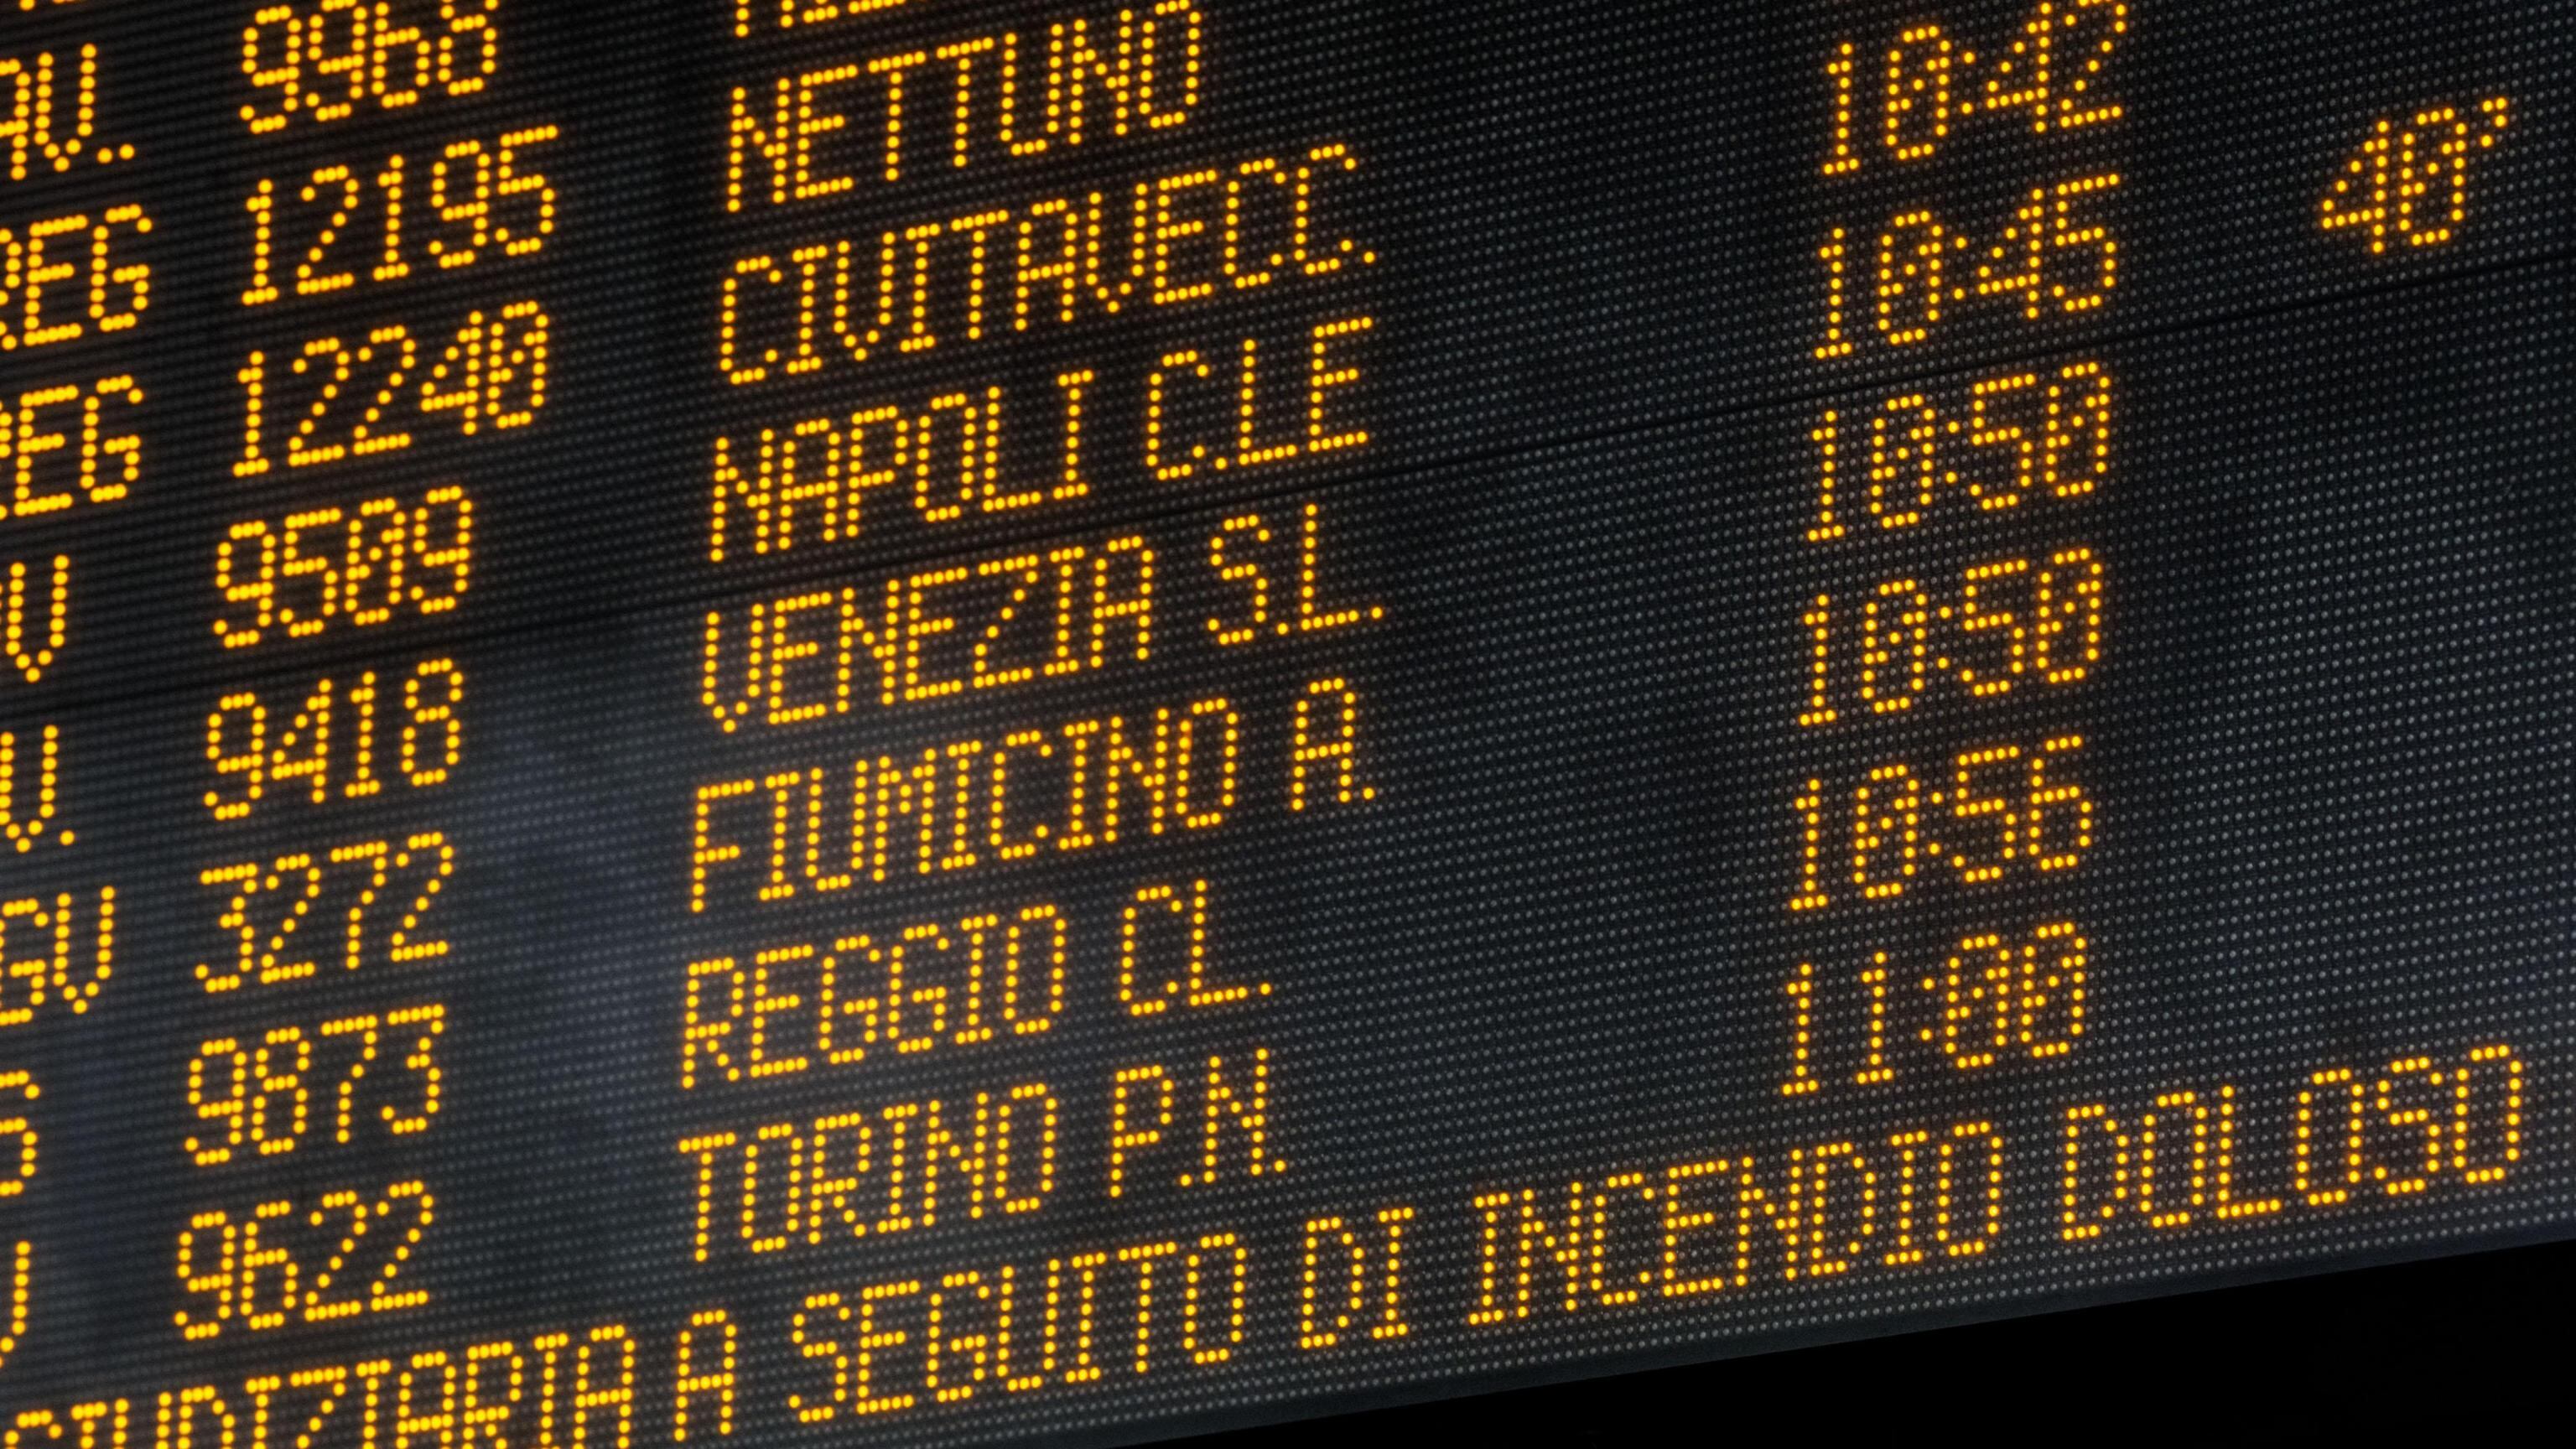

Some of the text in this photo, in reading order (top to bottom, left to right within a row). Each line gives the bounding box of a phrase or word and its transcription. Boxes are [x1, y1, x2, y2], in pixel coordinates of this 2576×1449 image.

[0, 0, 2127, 522] EG 12240 CIVITAVECC. 10:42
[238, 0, 500, 135] 9968
[240, 123, 559, 307] 12195
[726, 0, 1202, 213] NETTUNO
[202, 657, 465, 822] 9418
[700, 534, 1156, 735] VENEZIA
[1206, 502, 1384, 647] S.L.
[1806, 361, 2111, 543] 10:50
[212, 484, 474, 650] 9509
[709, 368, 1095, 563] NAPOLI
[1145, 315, 1374, 481] C.LE
[1814, 173, 2121, 360] 10:45
[183, 1002, 446, 1167] 9873
[680, 903, 1068, 1090] REGGIO
[1118, 878, 1273, 1017] CL.
[1789, 734, 2094, 911] 10:56
[193, 830, 455, 995] 3272
[689, 697, 1239, 914] FIUMICINO
[1290, 676, 1376, 812] A.
[1798, 547, 2104, 727] 10:50
[173, 1179, 435, 1342] 9622
[677, 1082, 1059, 1263] TORINO
[1109, 1047, 1288, 1198] P.N.
[1781, 921, 2088, 1097] 11:00
[673, 1308, 739, 1443] A
[787, 1232, 1248, 1424] SEGUITO
[1299, 1206, 1415, 1350] DI
[1467, 1120, 2004, 1327] INCENDIO
[2061, 1043, 2524, 1242] DOLOSO
